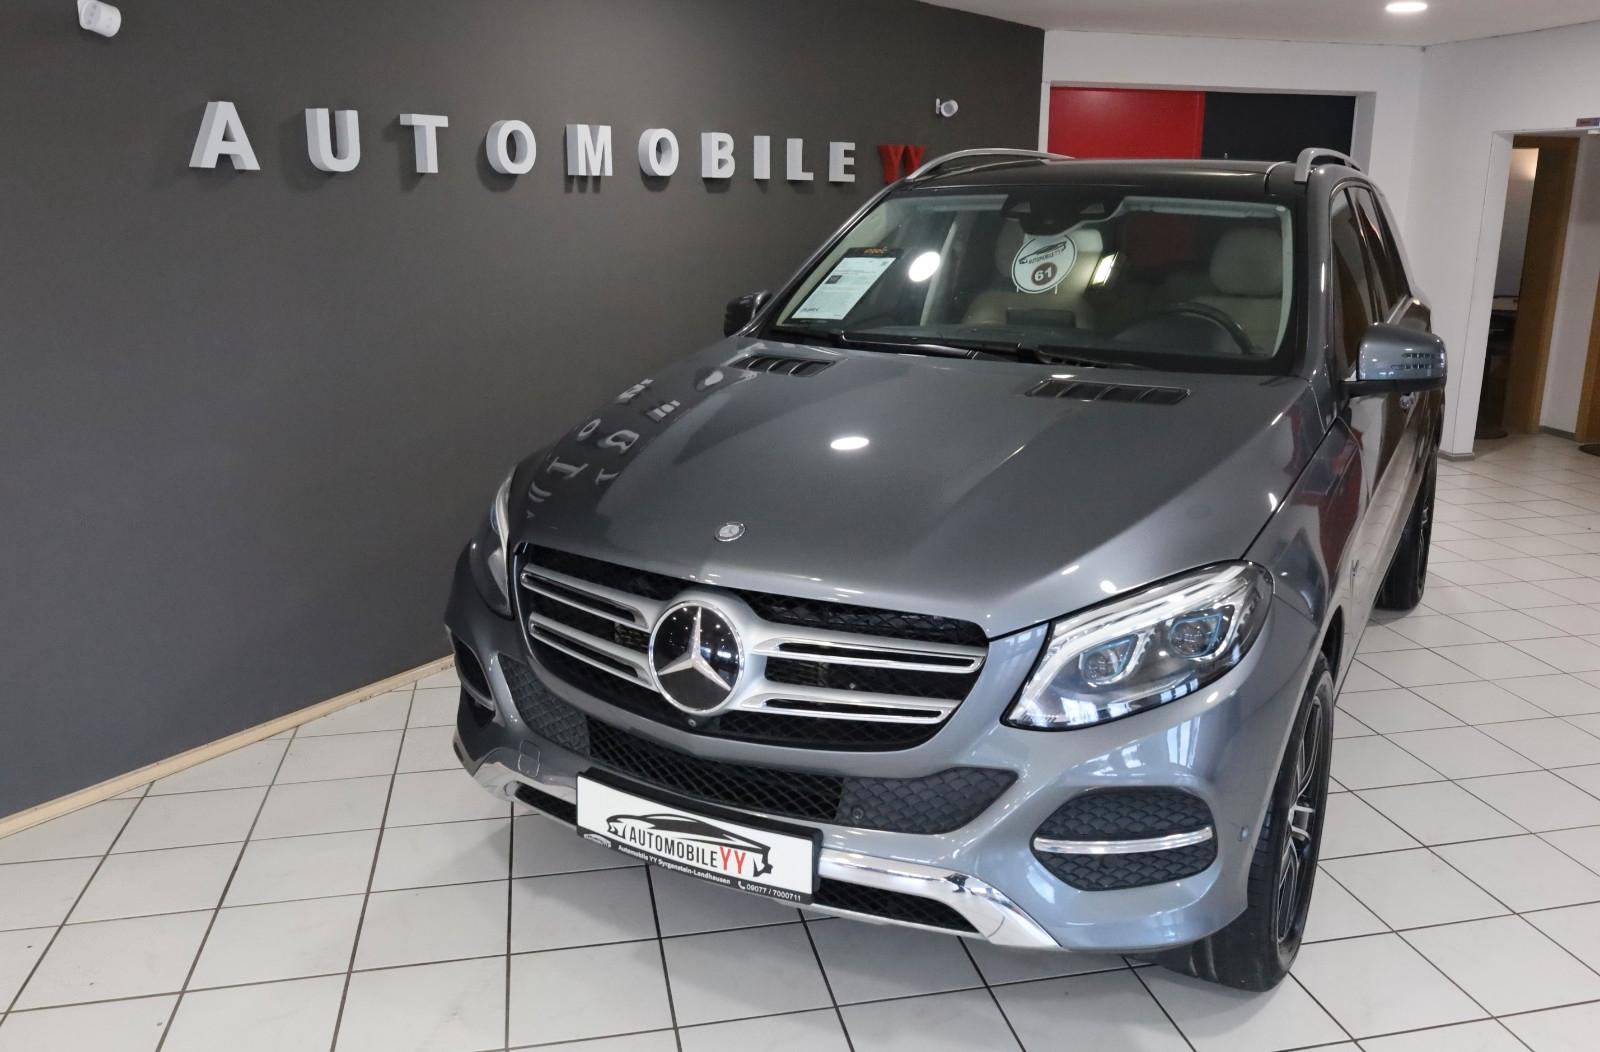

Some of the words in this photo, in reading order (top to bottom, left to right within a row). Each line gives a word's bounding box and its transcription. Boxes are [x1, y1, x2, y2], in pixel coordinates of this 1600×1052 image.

[189, 101, 855, 182] AUTOMOBILE
[878, 144, 925, 184] YY
[1034, 266, 1052, 282] 61
[618, 844, 648, 861] Automobile
[649, 855, 658, 864] YY
[746, 883, 767, 894] 09077
[773, 889, 801, 901] 7000711
